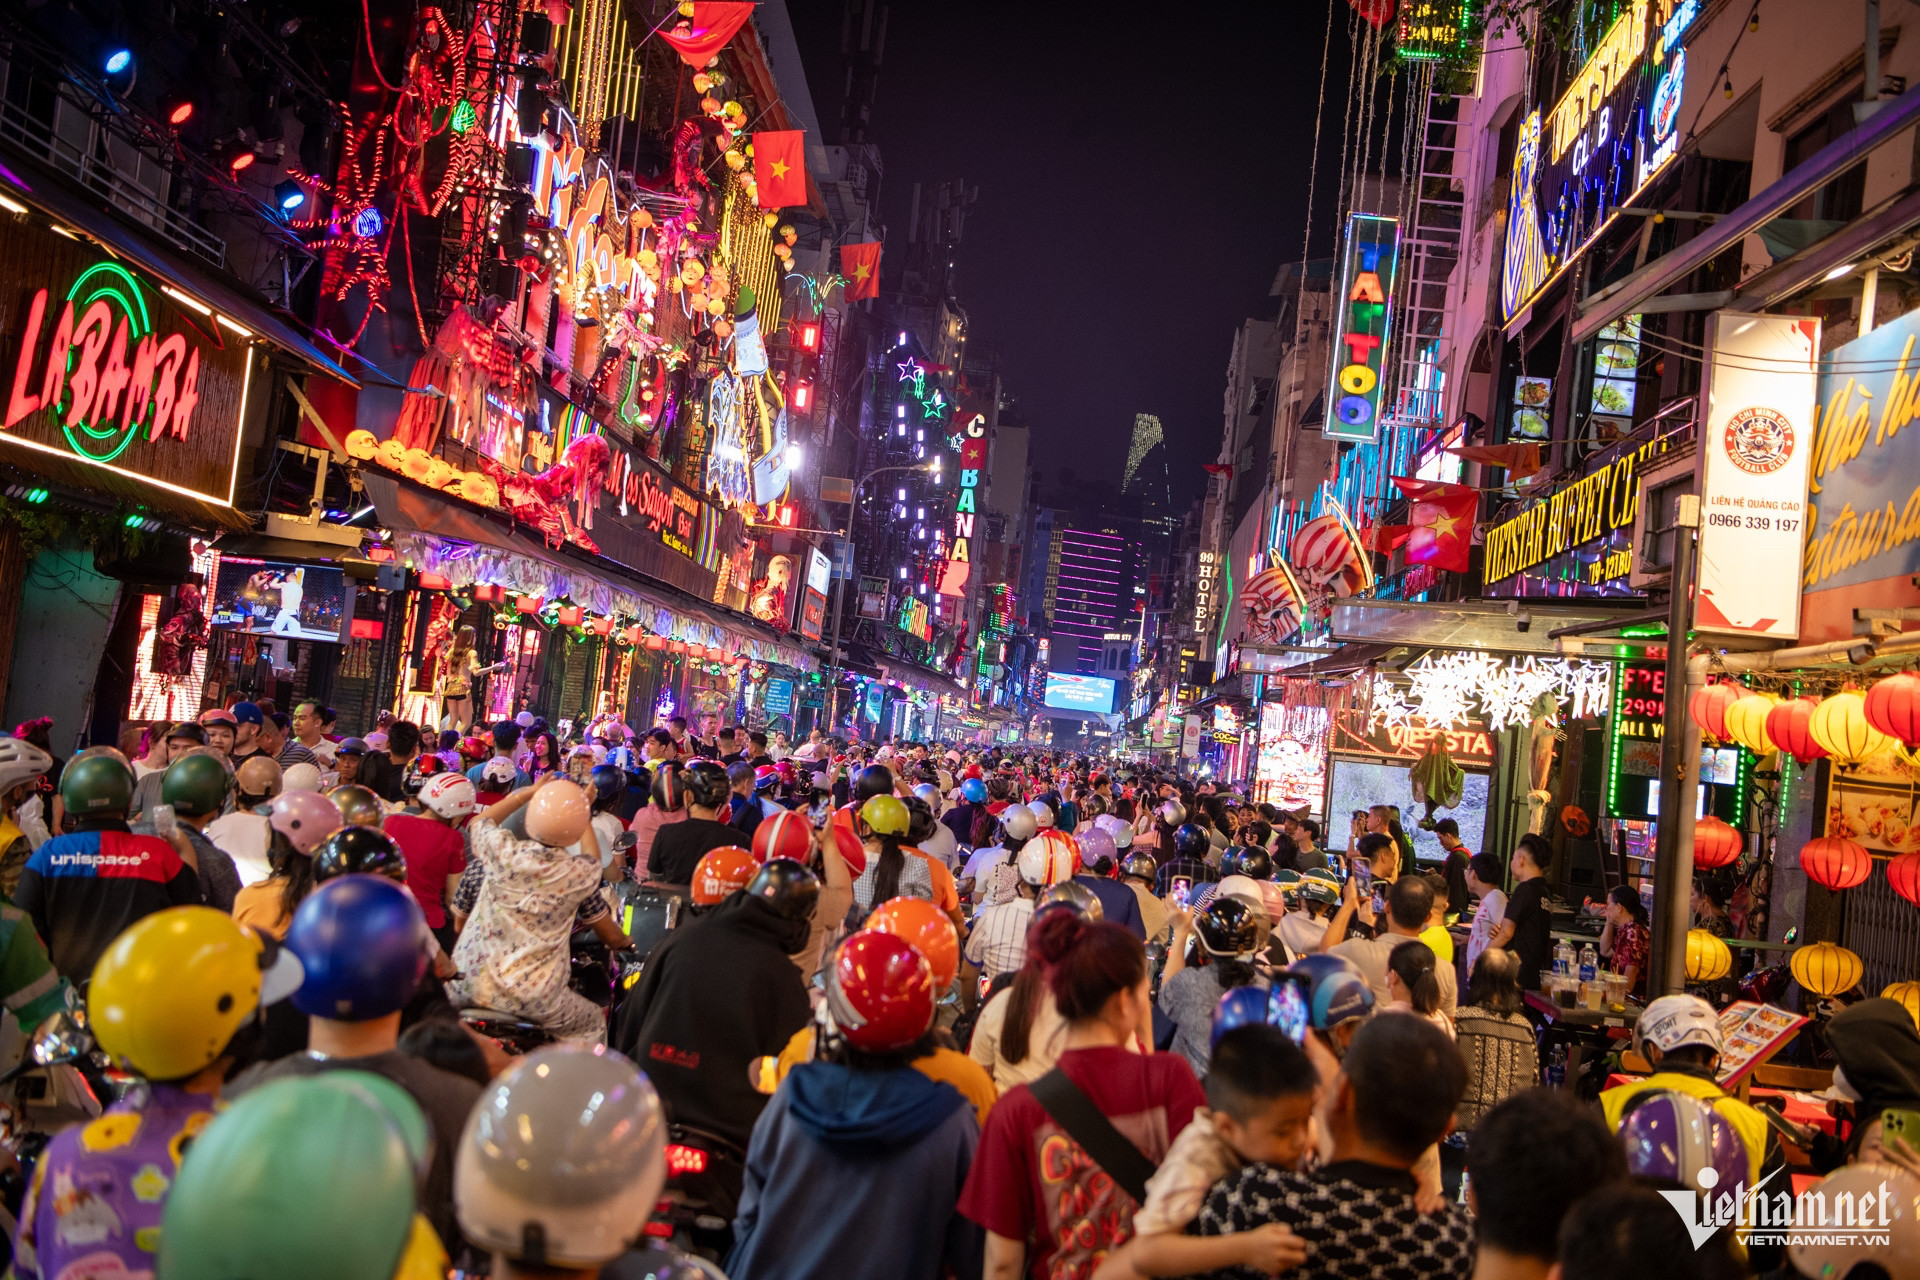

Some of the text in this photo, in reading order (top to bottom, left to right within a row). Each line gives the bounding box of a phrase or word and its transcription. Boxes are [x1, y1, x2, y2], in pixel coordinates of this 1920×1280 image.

[1551, 0, 1648, 166] VIETSTAR
[1335, 241, 1391, 426] TATTOO
[1728, 407, 1793, 435] HO CHI MINH CITY
[1728, 449, 1790, 474] FOOTBALL CLUB
[950, 413, 986, 563] CBANA
[1711, 495, 1731, 507] LIÊN
[1485, 502, 1547, 586] VIETSTAR
[1545, 463, 1612, 560] BUFFET
[1709, 513, 1799, 532] 0966 339 197
[1200, 551, 1214, 563] 99
[1194, 565, 1213, 633] HOTEL
[1624, 668, 1665, 694] FRE
[1387, 725, 1493, 756] VIESTA
[1620, 720, 1646, 736] ALL
[1654, 1016, 1677, 1036] SPORT
